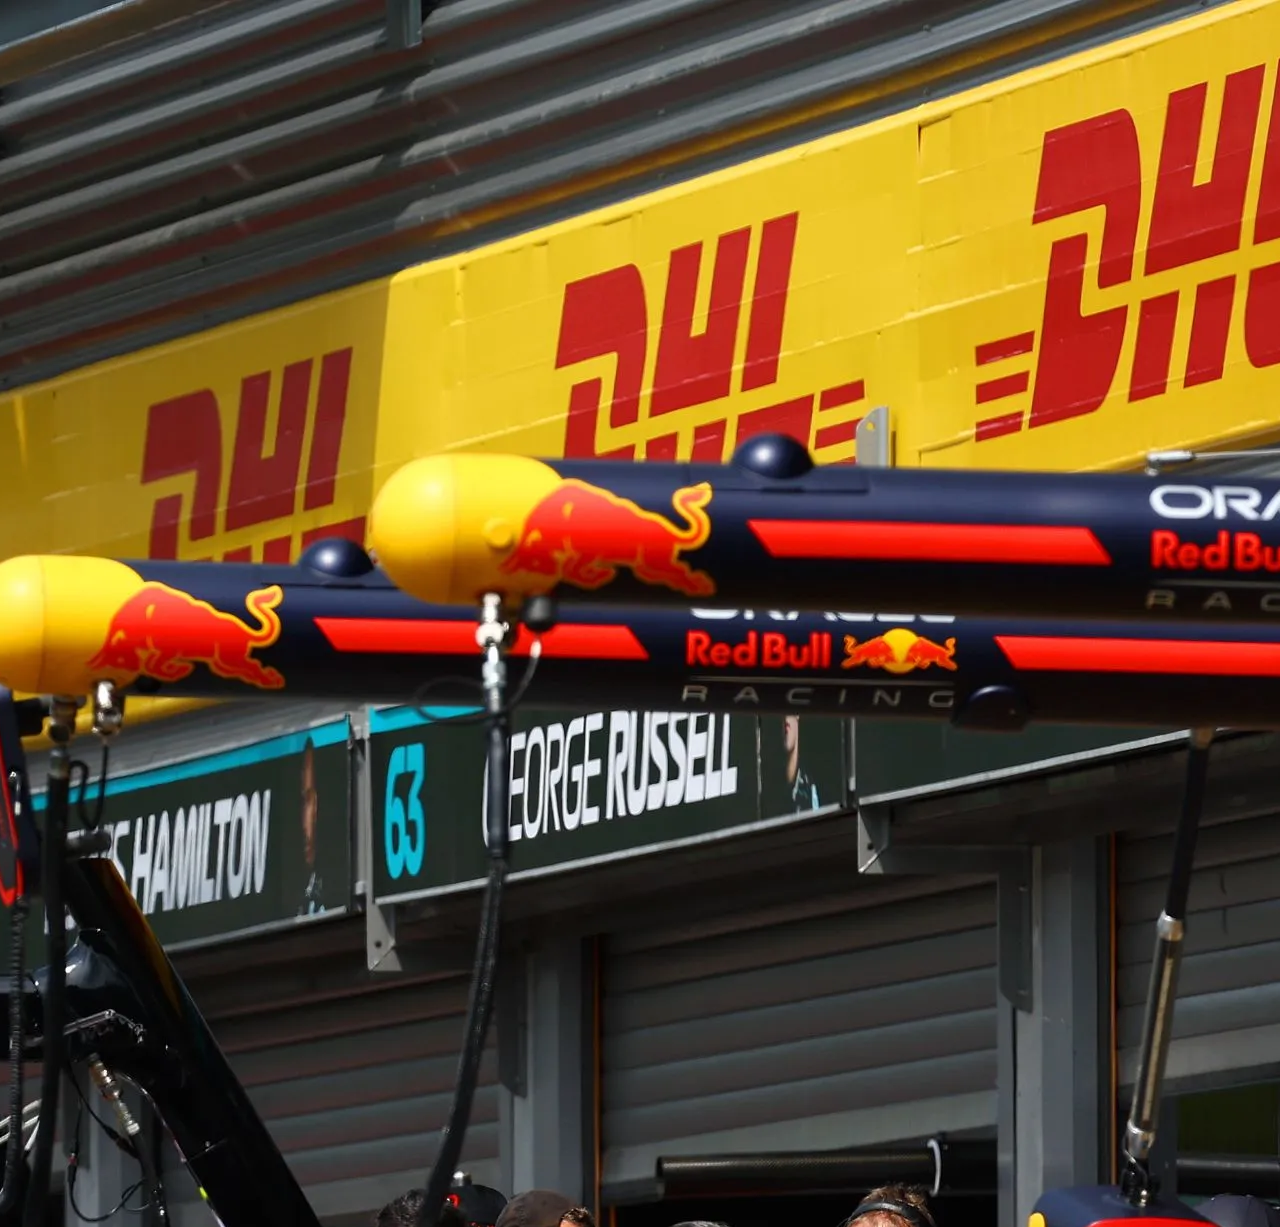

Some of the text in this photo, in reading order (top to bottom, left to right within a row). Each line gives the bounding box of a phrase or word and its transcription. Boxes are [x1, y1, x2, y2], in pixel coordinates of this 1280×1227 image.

[554, 211, 814, 463] DHL
[1151, 530, 1222, 571] Red
[686, 630, 831, 669] Red Bull
[681, 684, 955, 709] RACING
[385, 710, 738, 879] 63 EORGE RUSSELL
[131, 788, 272, 915] HAMILTON
